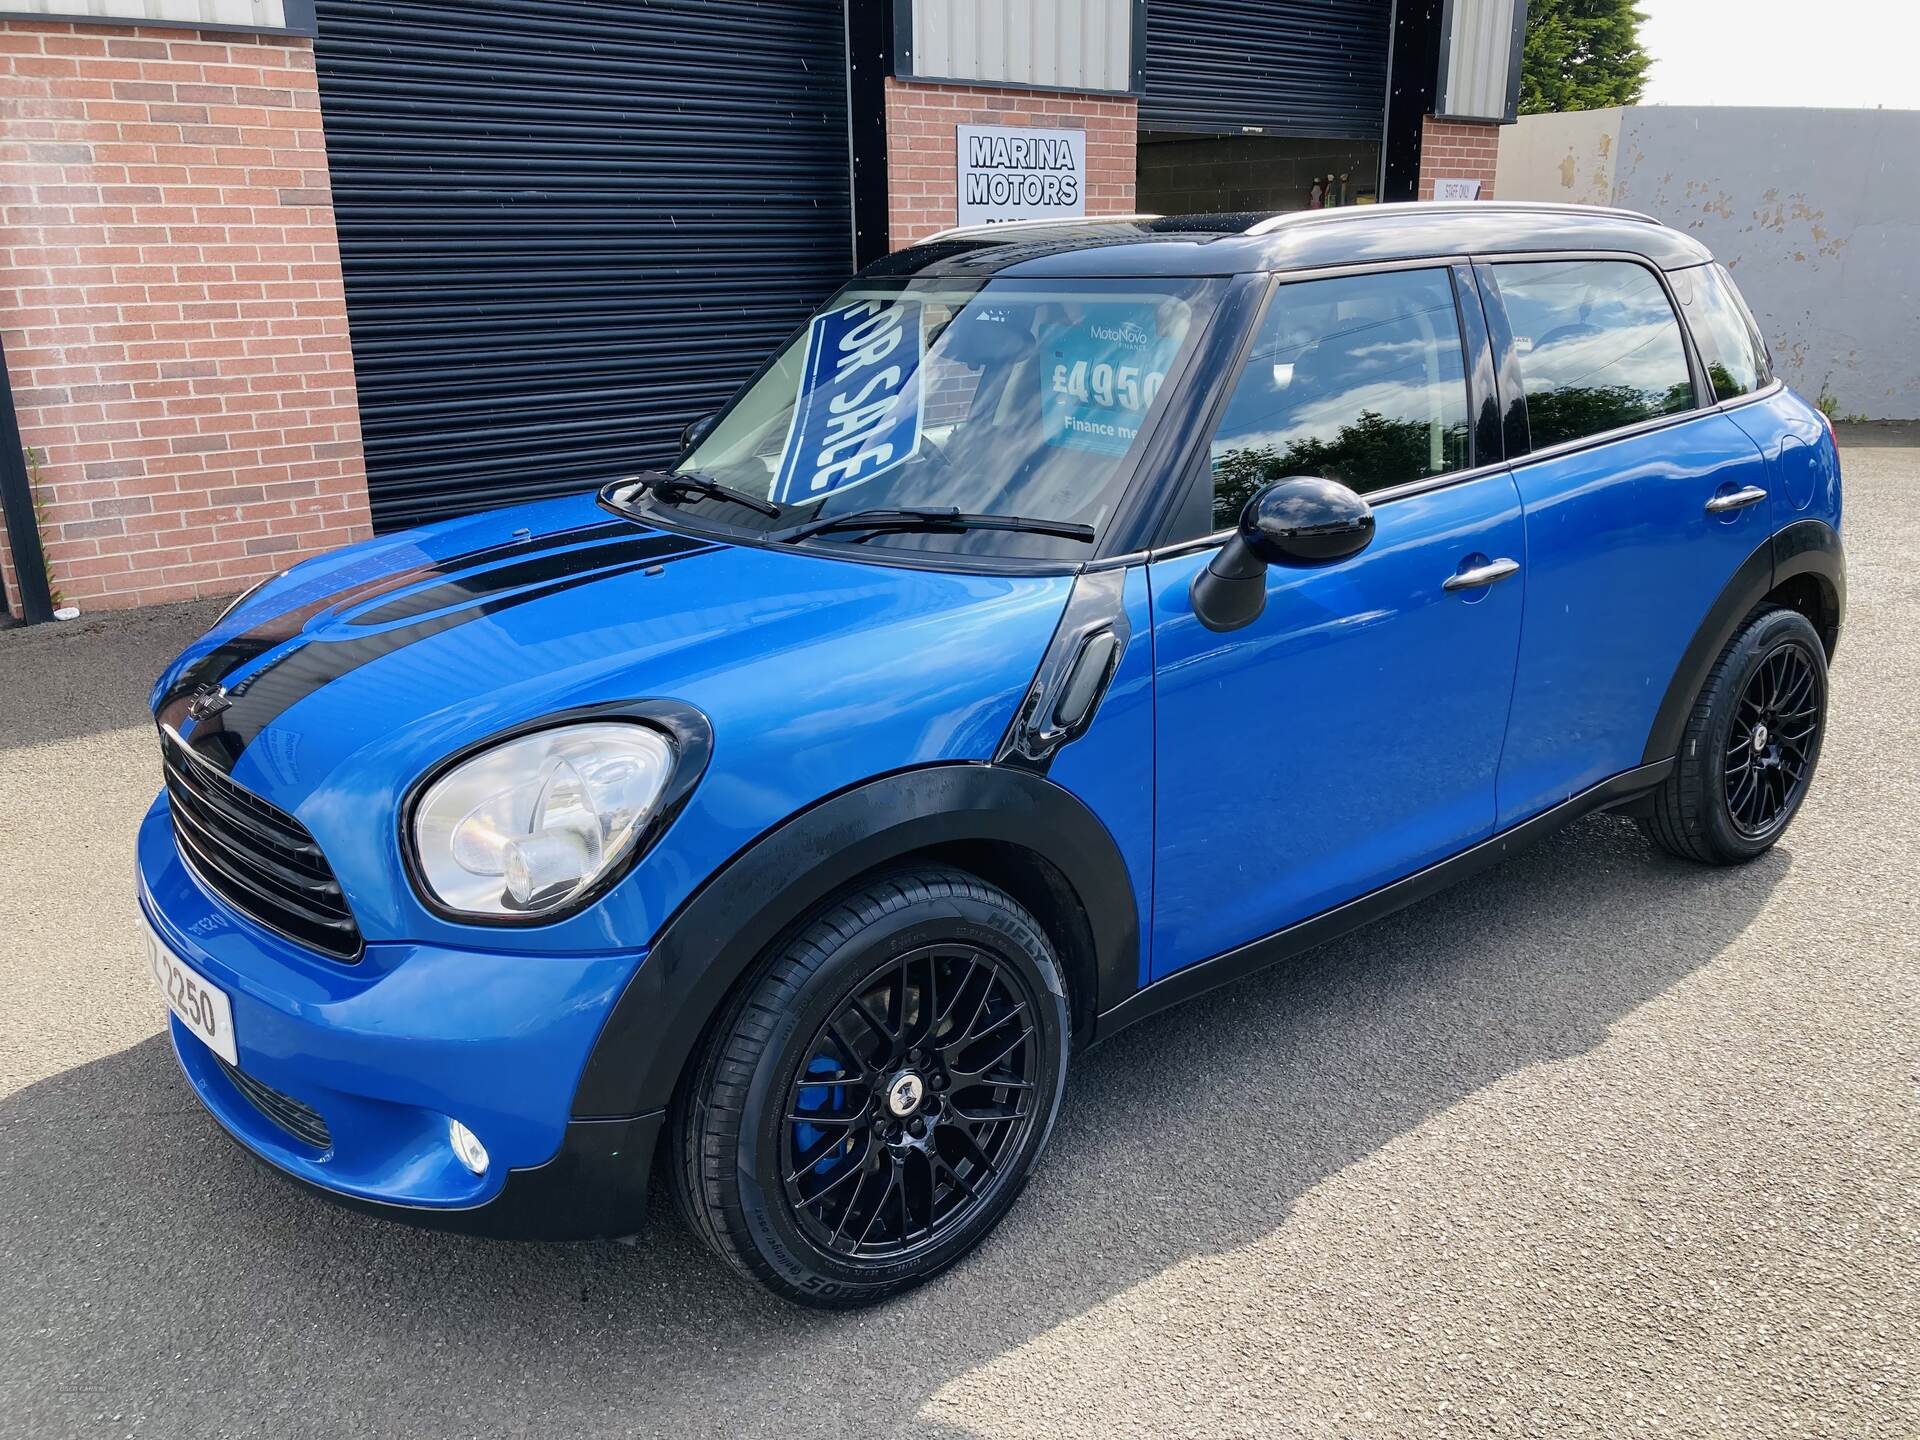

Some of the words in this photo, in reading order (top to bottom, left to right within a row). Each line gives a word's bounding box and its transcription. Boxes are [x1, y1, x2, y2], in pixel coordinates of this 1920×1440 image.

[969, 136, 1075, 170] MARINA
[967, 173, 1078, 206] MOTORS
[834, 300, 905, 384] FOR
[1090, 325, 1148, 344] MotoNovo
[1053, 360, 1165, 411] £4950
[810, 365, 901, 491] SALE
[1064, 416, 1115, 437] Finance
[987, 911, 1049, 963] HIFLY
[163, 955, 216, 1037] 2250
